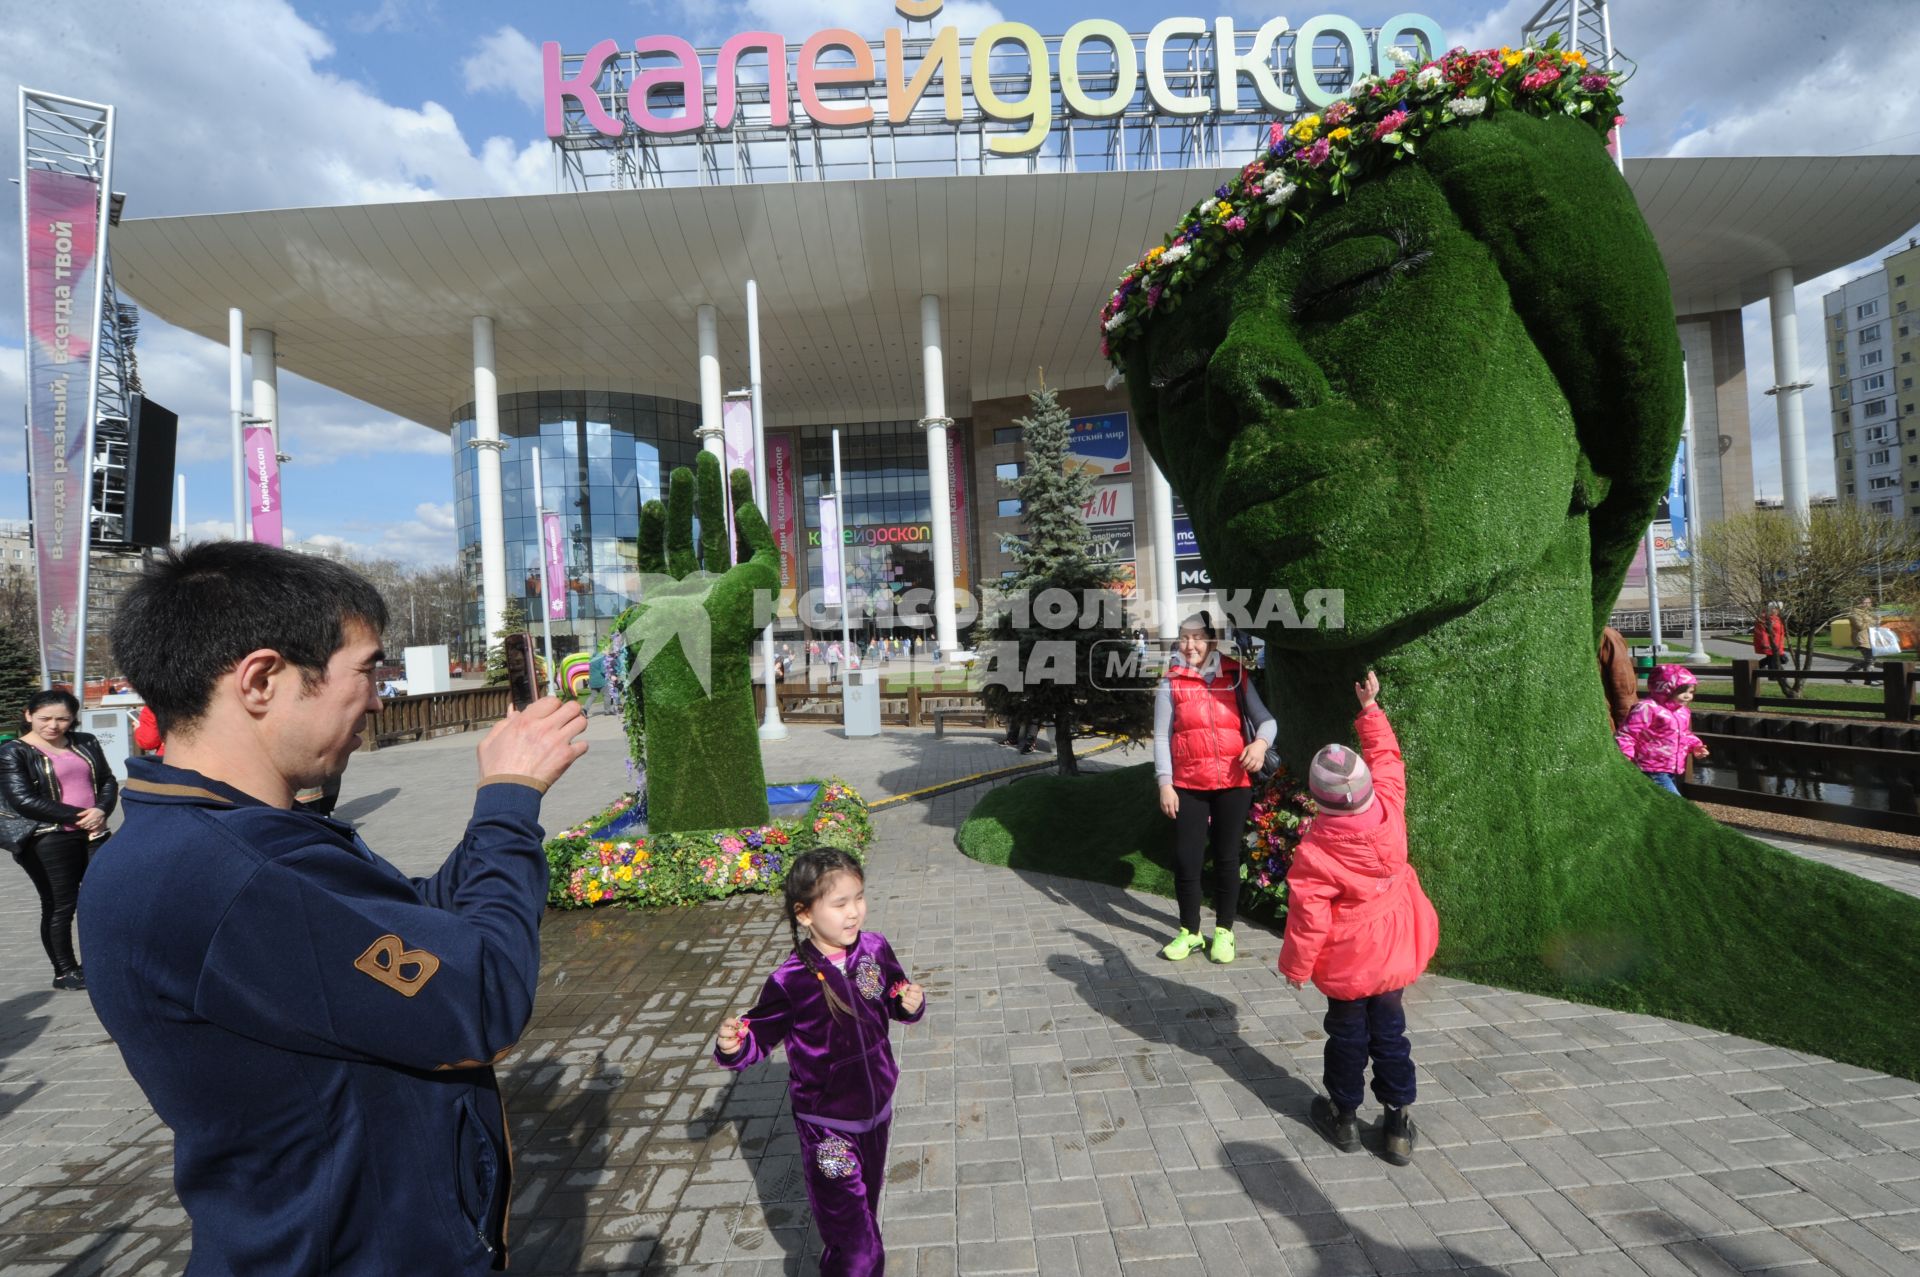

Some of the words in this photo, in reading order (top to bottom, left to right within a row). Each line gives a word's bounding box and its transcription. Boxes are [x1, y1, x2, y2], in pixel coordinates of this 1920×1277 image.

[1105, 431, 1124, 440] мир
[257, 447, 271, 513] Калейдоскоп
[775, 446, 786, 521] Калейдоскопе
